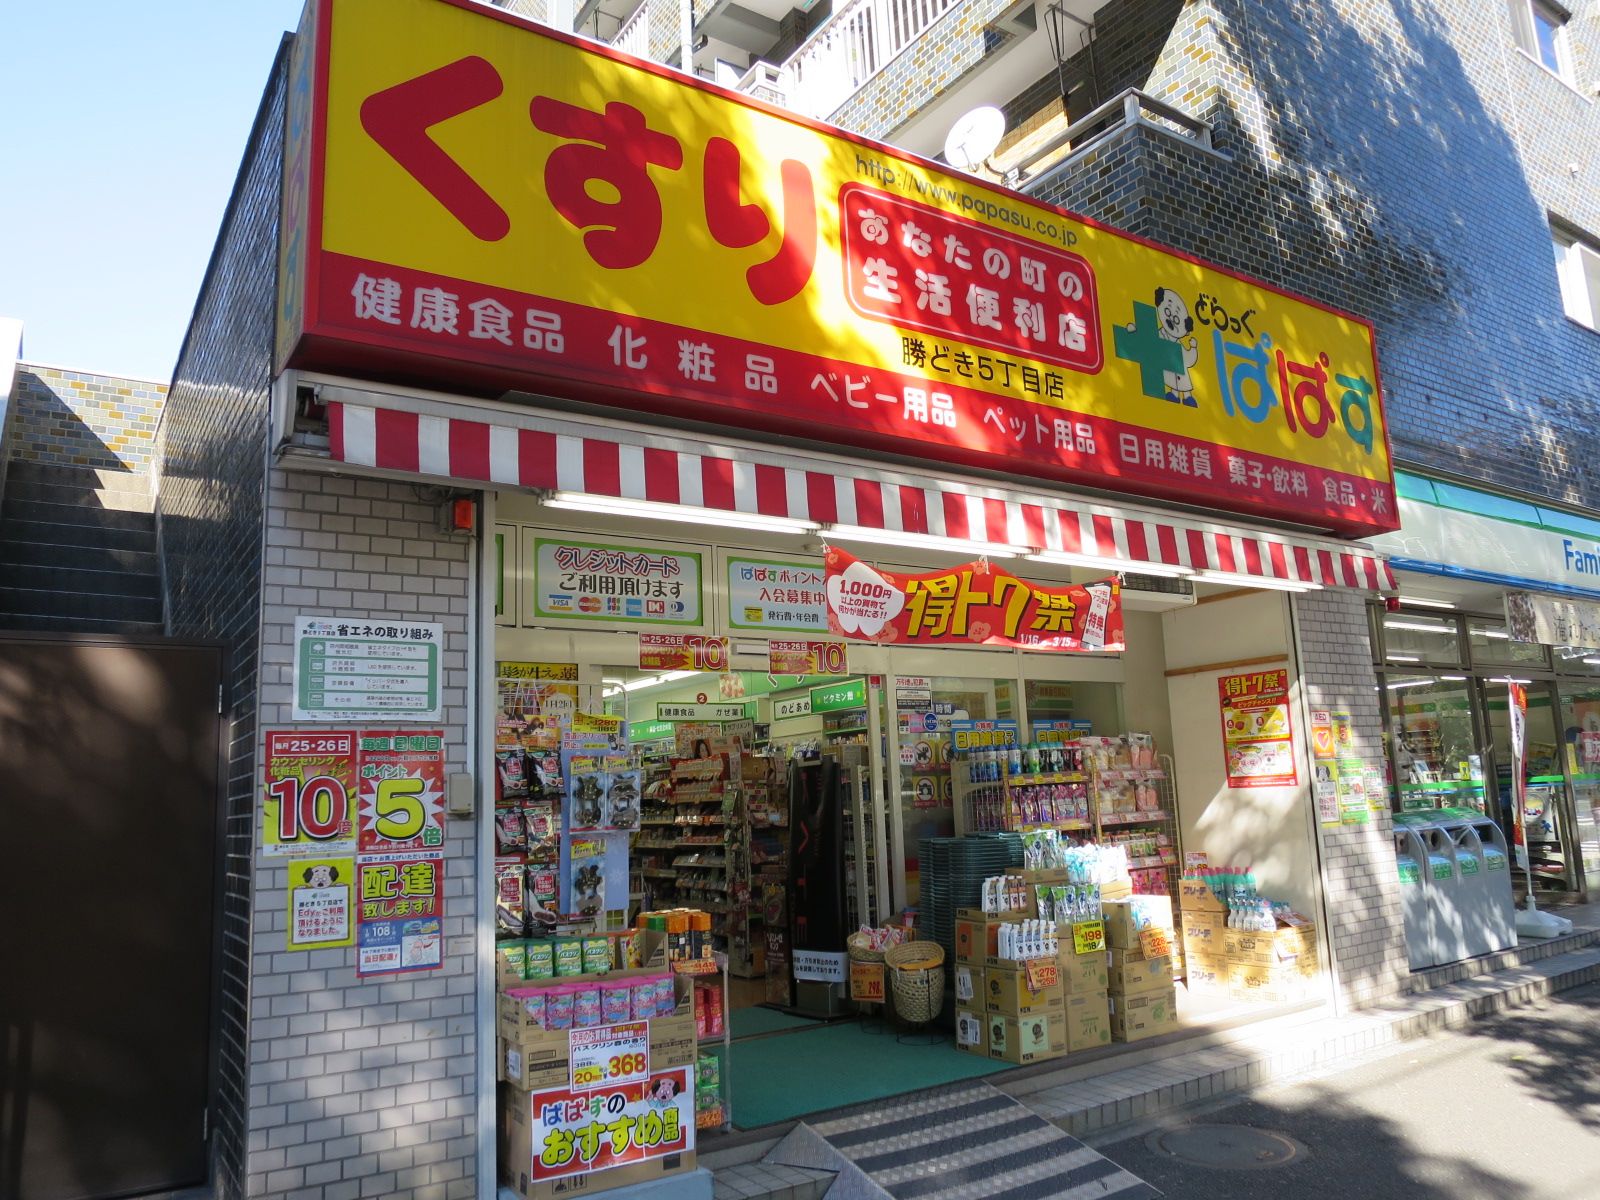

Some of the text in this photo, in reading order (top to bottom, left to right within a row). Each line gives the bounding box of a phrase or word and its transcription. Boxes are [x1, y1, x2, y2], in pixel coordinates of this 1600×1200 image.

[360, 55, 817, 305] くすり
[855, 154, 1079, 247] http://www.papasu.co.jp
[858, 208, 1084, 302] あなたの町の
[862, 257, 1088, 353] 生活便利店
[1194, 293, 1256, 338] どらっぐ
[351, 273, 565, 354] 健康食品
[607, 324, 778, 394] 化粧品
[811, 373, 957, 428] ベビー用品
[983, 407, 1096, 455] ペット用品
[1119, 434, 1212, 480] 日用雑貨
[901, 336, 1065, 401] 勝どき5丁目店
[1212, 328, 1374, 455] ぱぱす
[554, 546, 681, 579] クレジットカード
[552, 599, 569, 607] VISA
[558, 572, 685, 599] ご利用頂けます
[840, 579, 892, 599] 1,000円
[904, 570, 1076, 638] 得トク祭
[337, 623, 434, 640] 省エネの取り組み
[362, 862, 436, 900] 配達
[608, 1052, 646, 1077] 368
[542, 1094, 626, 1127] ぱぱすの
